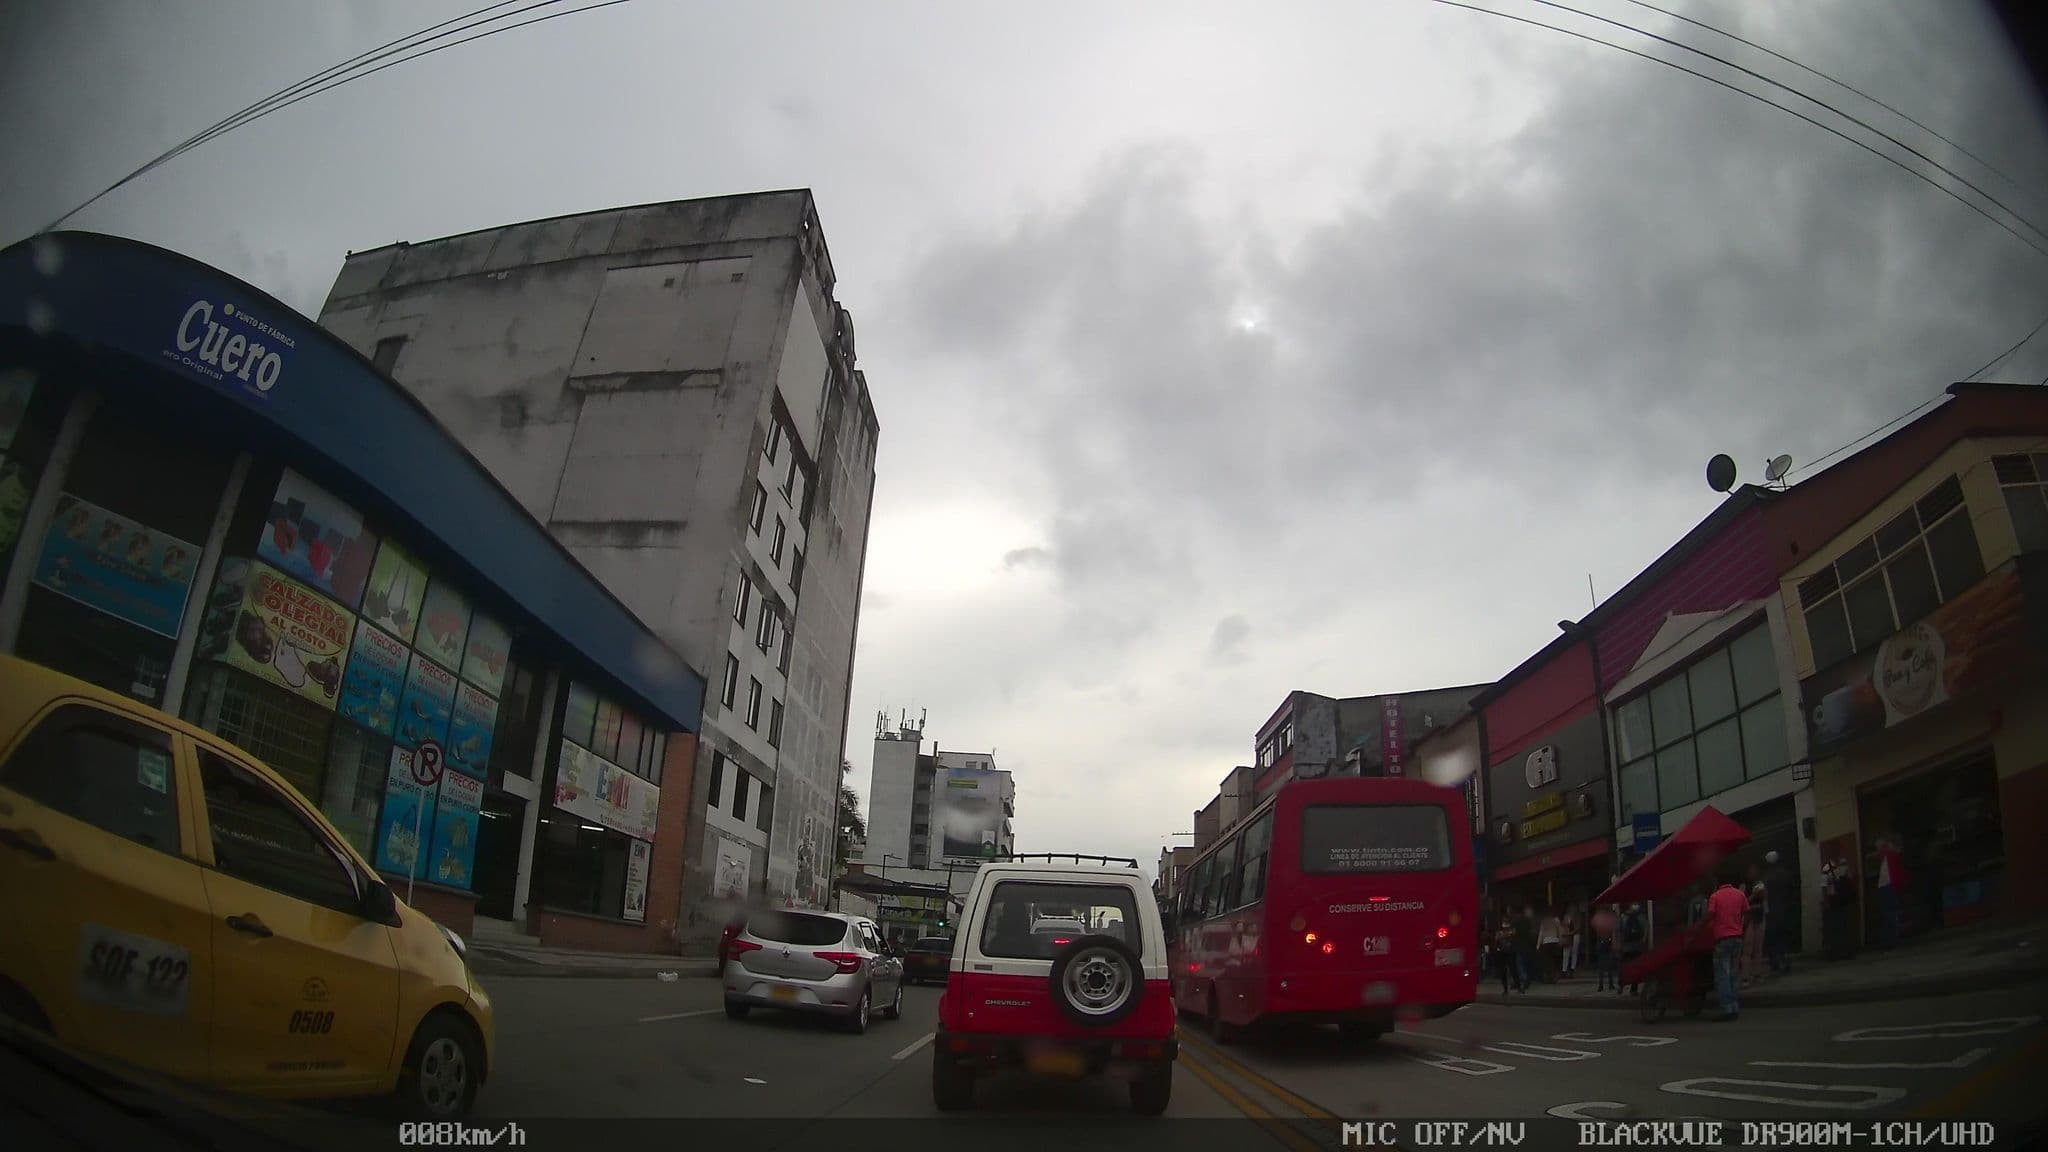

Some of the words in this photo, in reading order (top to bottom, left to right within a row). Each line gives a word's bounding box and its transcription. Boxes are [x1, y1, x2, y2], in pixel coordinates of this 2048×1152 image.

[235, 310, 258, 327] PUNTO
[258, 322, 268, 333] DE
[176, 299, 281, 392] Cuero
[182, 357, 223, 381] Original
[258, 575, 347, 629] CALZADO
[256, 590, 347, 648] OLEGIAL
[271, 616, 286, 630] AL
[290, 624, 327, 650] COSTO
[366, 627, 403, 658] PRECIOS
[1385, 698, 1399, 749] HOTEL
[448, 772, 480, 793] PRECIOS
[1328, 903, 1372, 914] CONSERVE
[1373, 902, 1384, 912] SU
[1384, 901, 1425, 911] DISTANCIA
[985, 999, 1032, 1007] CHEVROLET
